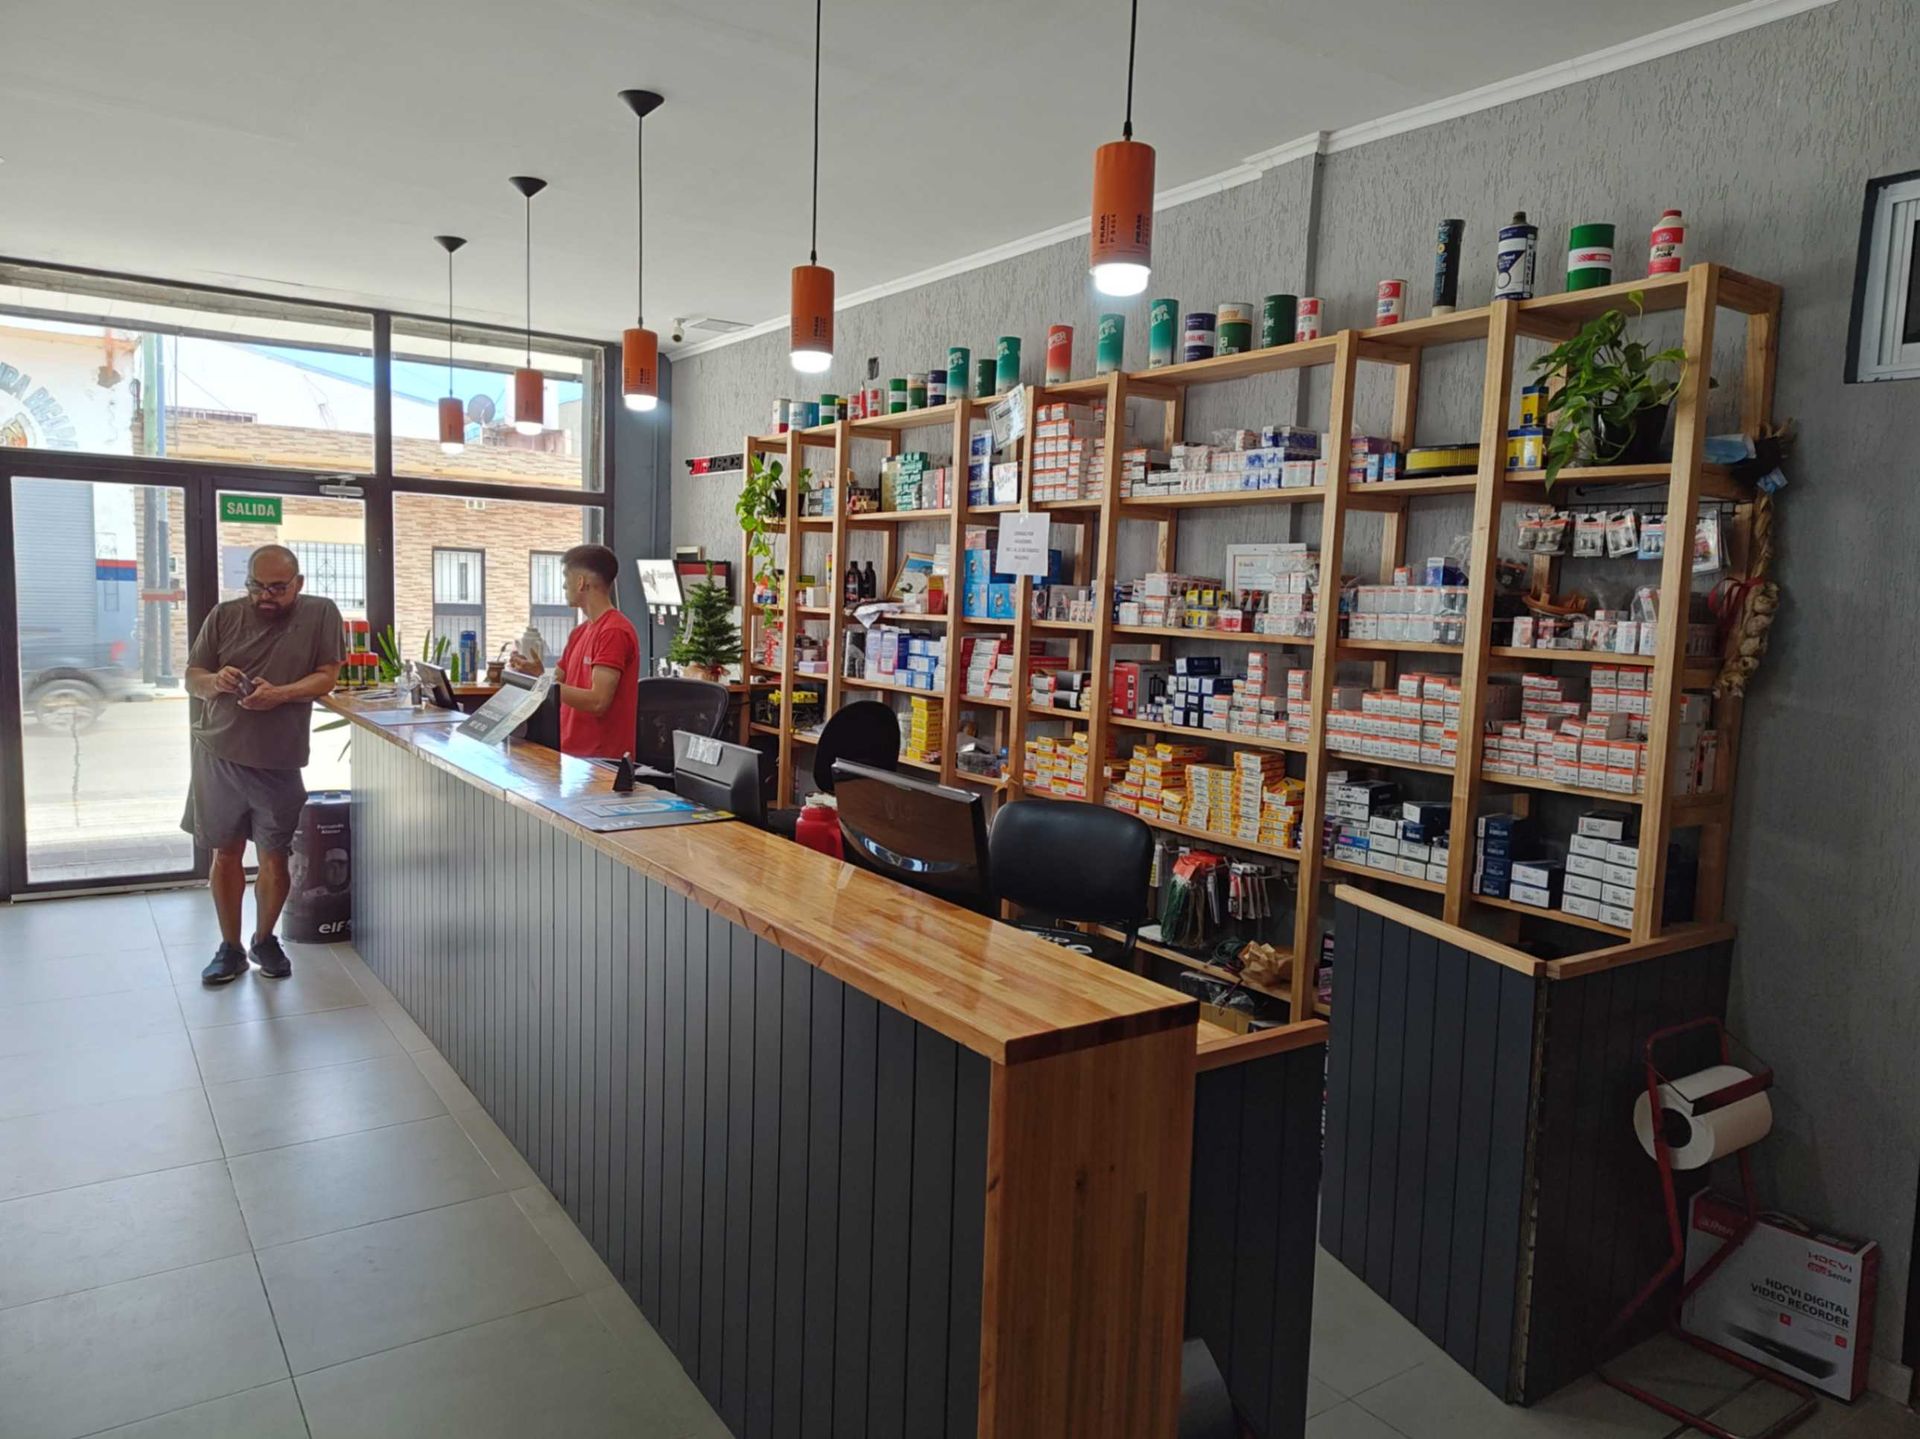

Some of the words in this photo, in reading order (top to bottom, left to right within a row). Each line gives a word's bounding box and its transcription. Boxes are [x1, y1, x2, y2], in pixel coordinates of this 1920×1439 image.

[227, 502, 276, 517] SALIDA
[318, 920, 345, 934] elf
[1808, 1252, 1852, 1272] HDCVI
[1750, 1282, 1786, 1303] VIDEO
[1788, 1297, 1850, 1329] RECORDER
[1765, 1278, 1801, 1298] HDCVI
[1804, 1292, 1850, 1318] DIGITAL
